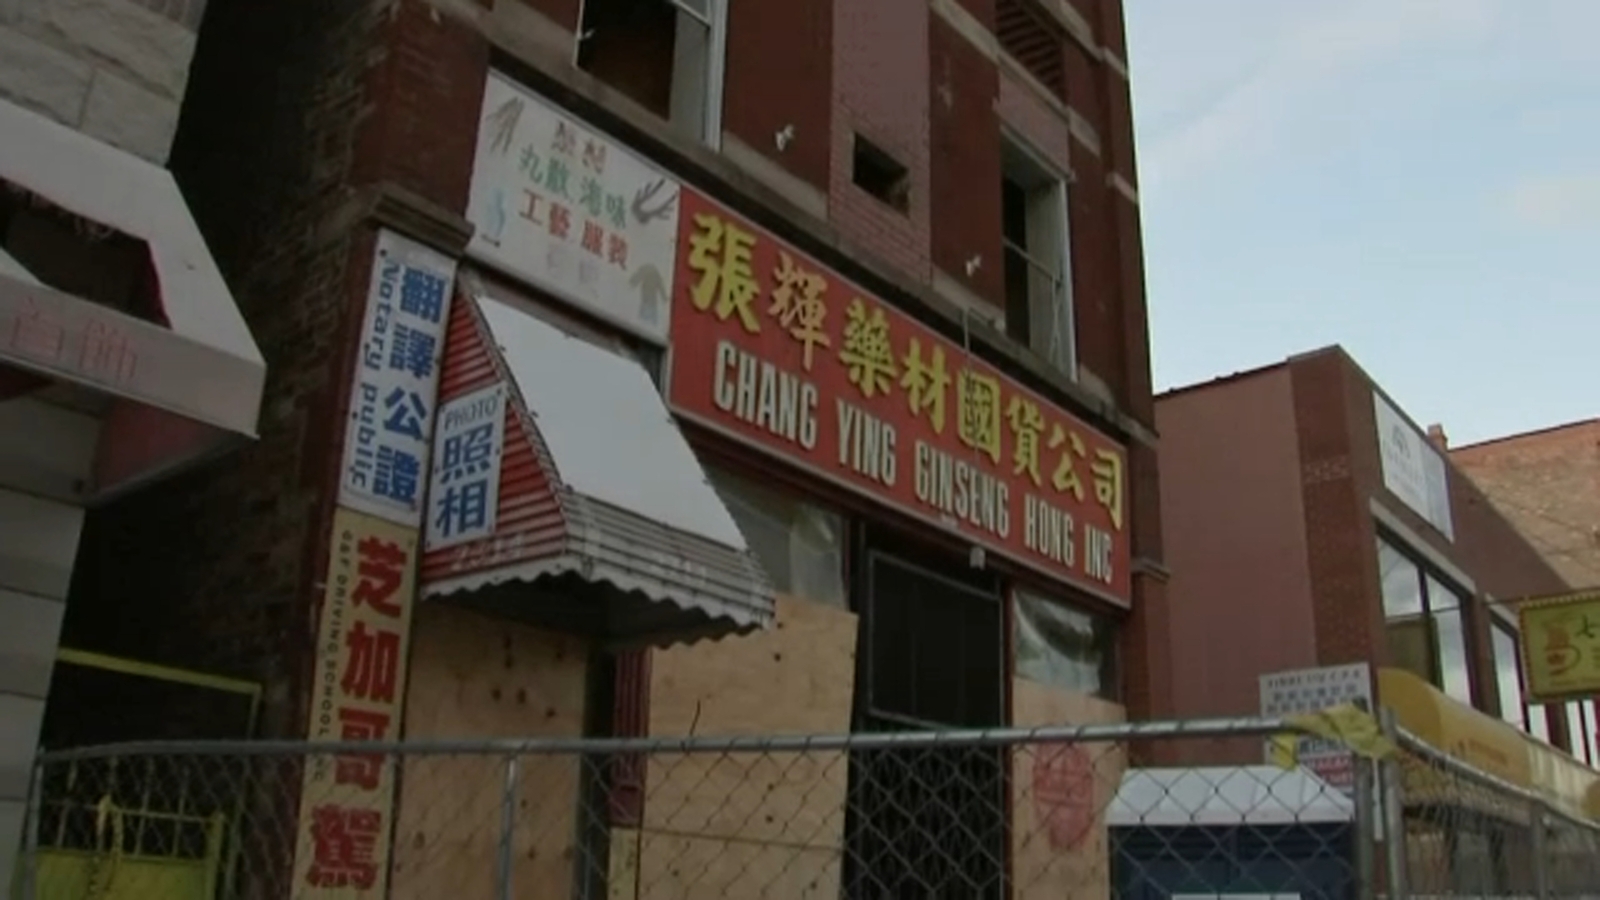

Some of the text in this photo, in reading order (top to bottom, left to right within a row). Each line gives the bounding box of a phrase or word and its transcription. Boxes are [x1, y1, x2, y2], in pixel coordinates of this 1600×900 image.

[352, 262, 400, 487] Notary public
[372, 266, 446, 504] 翻譯公證
[444, 397, 498, 430] PHOTO
[435, 422, 494, 538] 照相
[714, 341, 1113, 584] CHANG YING GINSENG HONG INC
[318, 659, 338, 737] SCHOOL
[328, 574, 347, 654] DRIVING
[306, 535, 408, 890] 芝加哥駕
